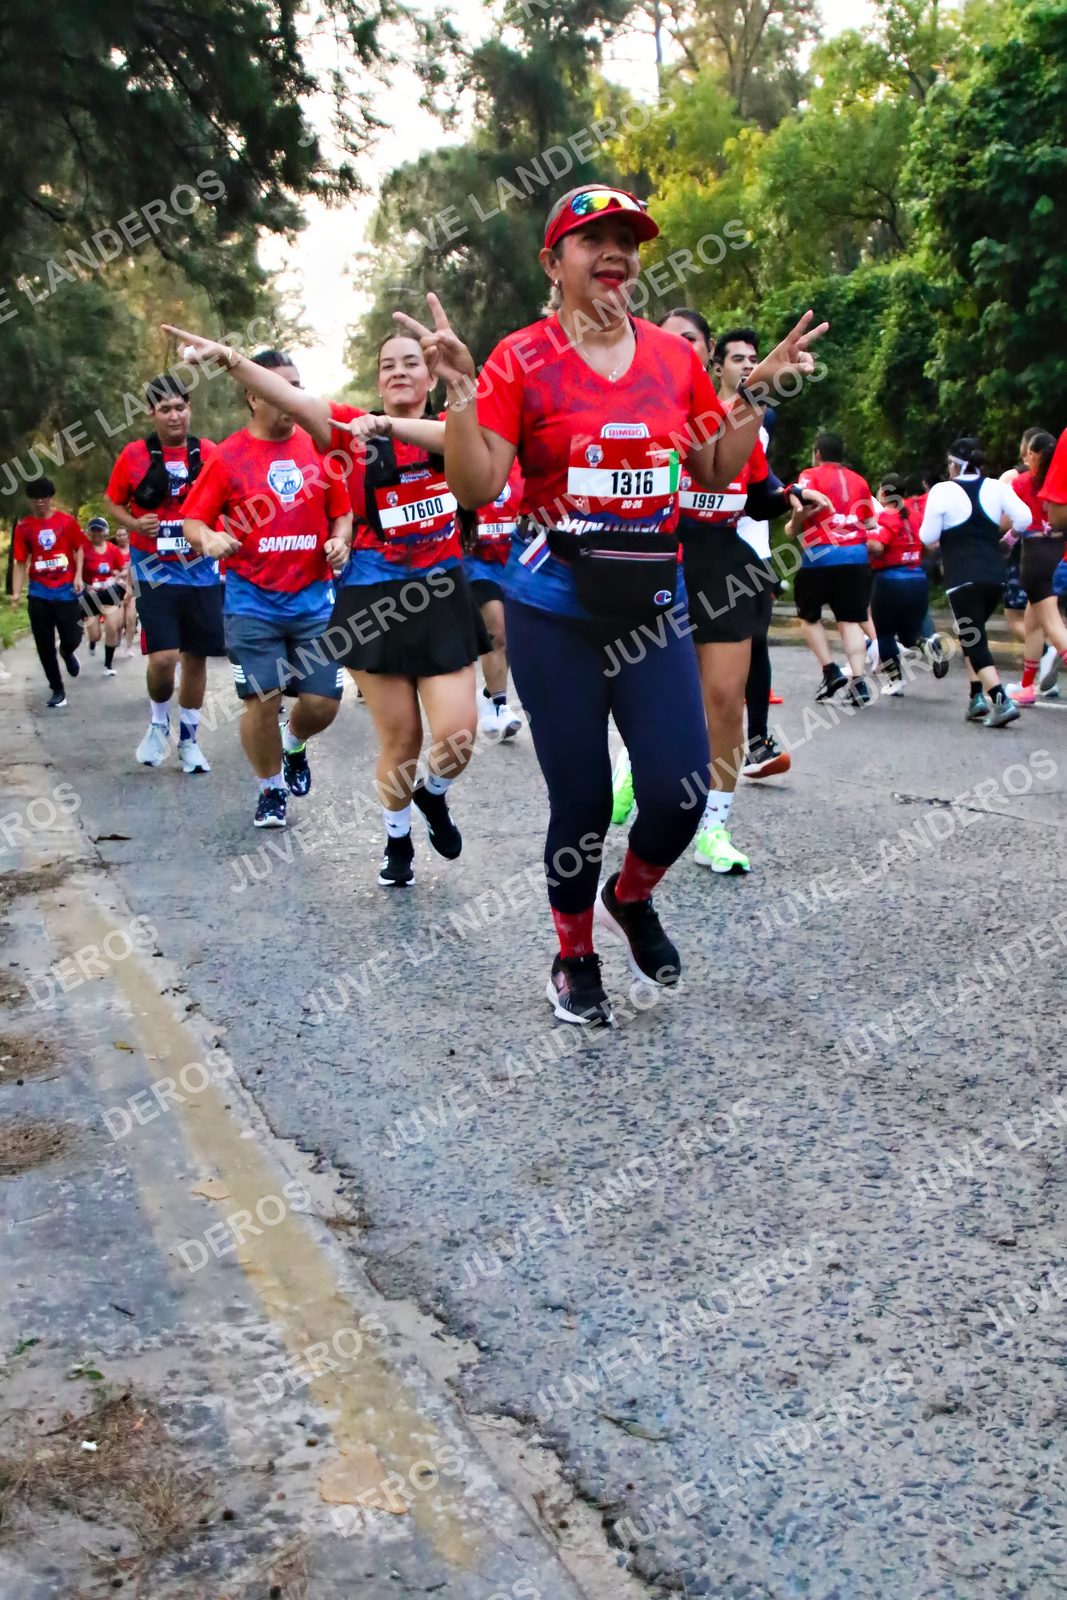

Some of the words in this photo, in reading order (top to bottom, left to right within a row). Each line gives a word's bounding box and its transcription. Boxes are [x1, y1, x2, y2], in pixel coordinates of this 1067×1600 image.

[608, 429, 643, 437] BIMBO
[611, 470, 654, 495] 1316
[402, 497, 444, 522] 17600
[692, 493, 725, 509] 1997
[258, 534, 317, 553] SANTIAGO
